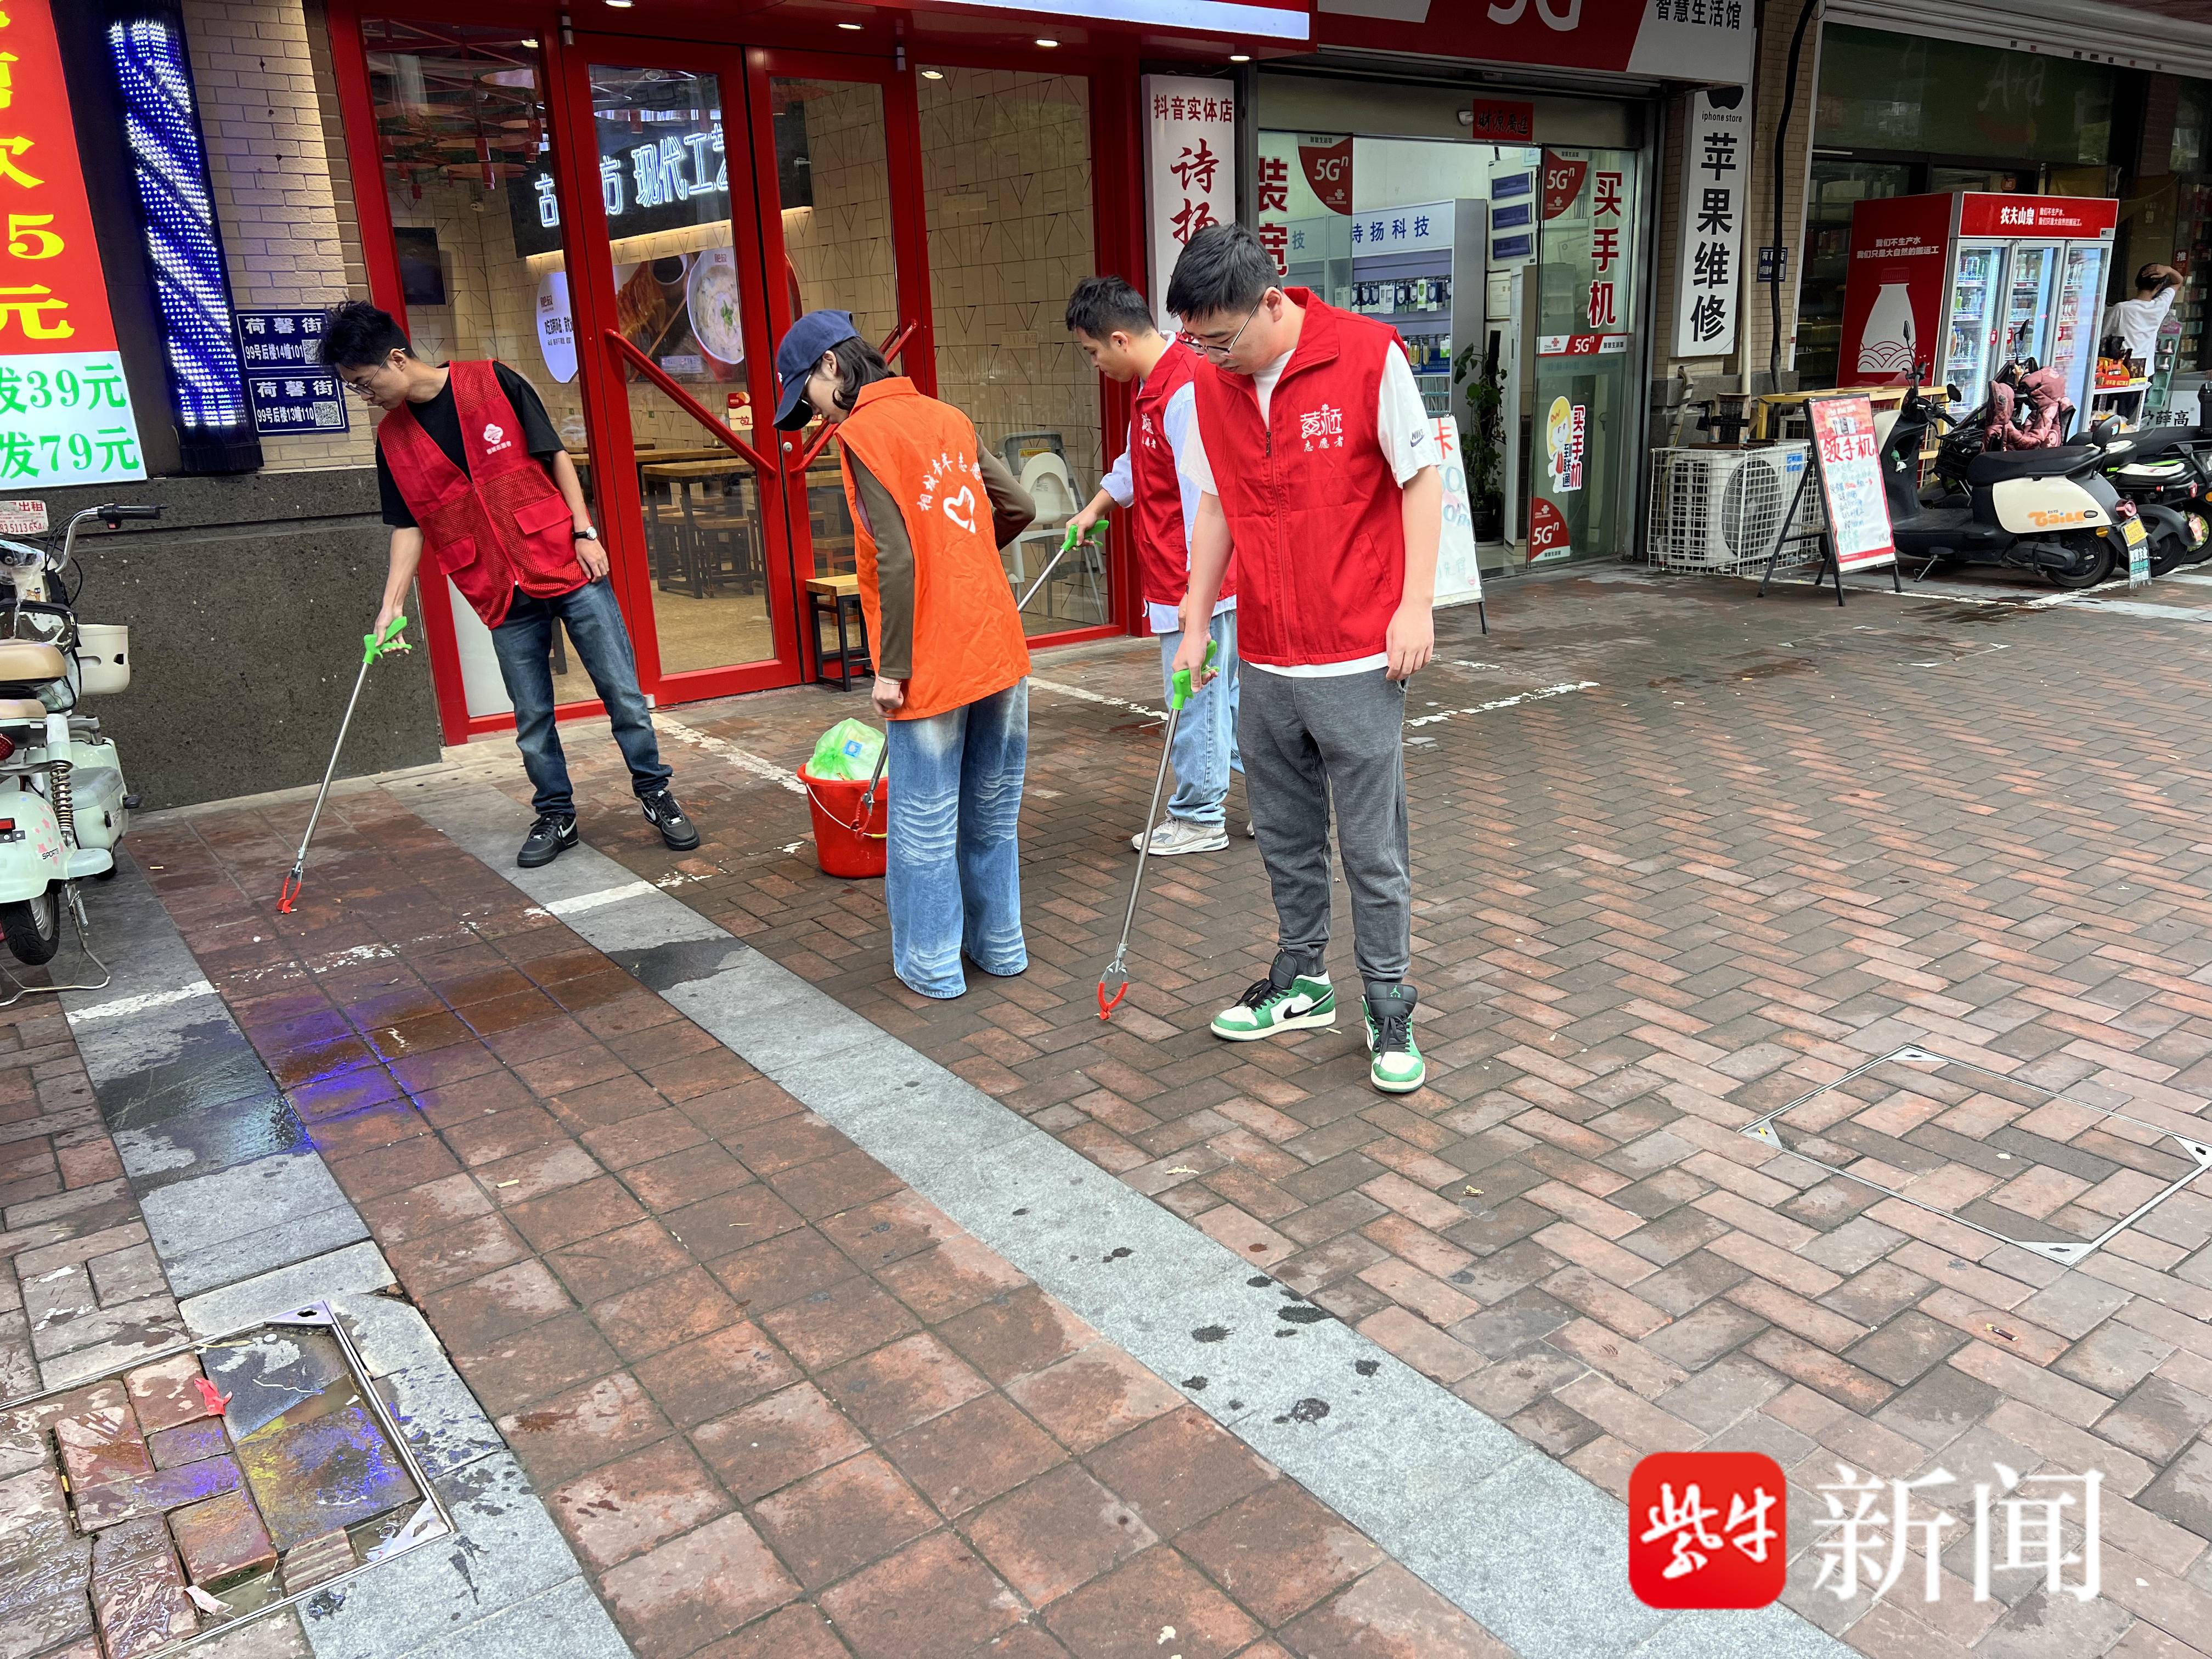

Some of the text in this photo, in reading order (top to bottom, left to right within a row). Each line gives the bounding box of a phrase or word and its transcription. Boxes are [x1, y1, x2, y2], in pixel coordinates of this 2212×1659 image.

[1656, 0, 1741, 30] 智慧生活馆
[1154, 94, 1233, 123] 抖音实体店
[1702, 111, 1742, 123] iphone store
[2000, 206, 2035, 225] 农夫山泉
[1588, 171, 1623, 328] 买手机
[1690, 132, 1738, 342] 苹果维修
[1875, 236, 1921, 247] 我们不生产水
[244, 317, 323, 334] 荷馨街
[0, 362, 127, 414] 发39元
[256, 380, 334, 398] 荷馨街
[0, 425, 140, 479] 发79元
[1304, 435, 1344, 453] 志愿者
[1434, 417, 1453, 460] 卡
[1571, 406, 1585, 488] 买手机
[42, 848, 59, 860] SPORTS
